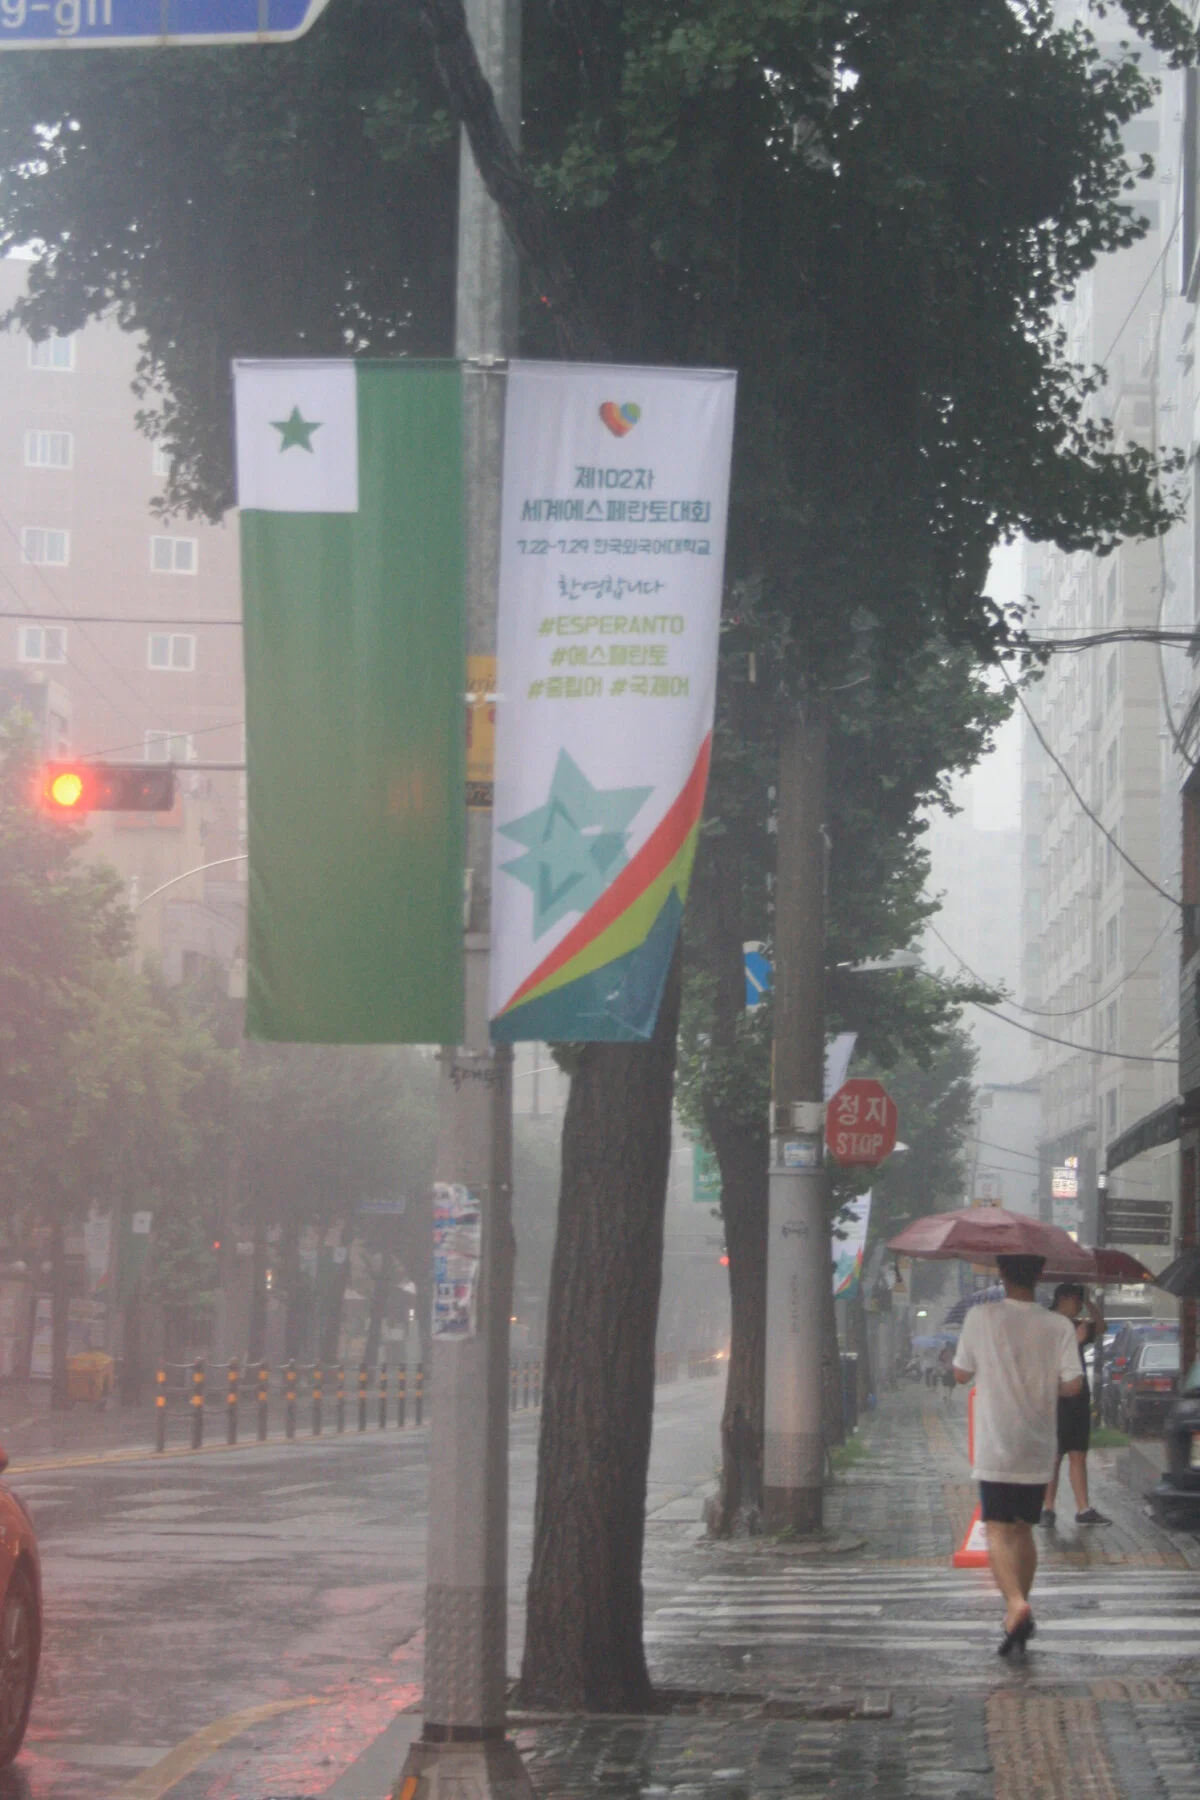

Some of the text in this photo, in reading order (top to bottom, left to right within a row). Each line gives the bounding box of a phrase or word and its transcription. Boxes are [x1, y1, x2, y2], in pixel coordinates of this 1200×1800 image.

[521, 499, 711, 523] 세계에스페란토대회
[594, 538, 711, 555] 한국외국어대학교
[558, 574, 665, 600] 환영합니다
[538, 615, 685, 637] #ESPERANTO
[551, 644, 669, 667] #에스페란토
[610, 675, 689, 698] #국제어
[836, 1092, 888, 1127] 정지
[836, 1131, 883, 1156] STOP
